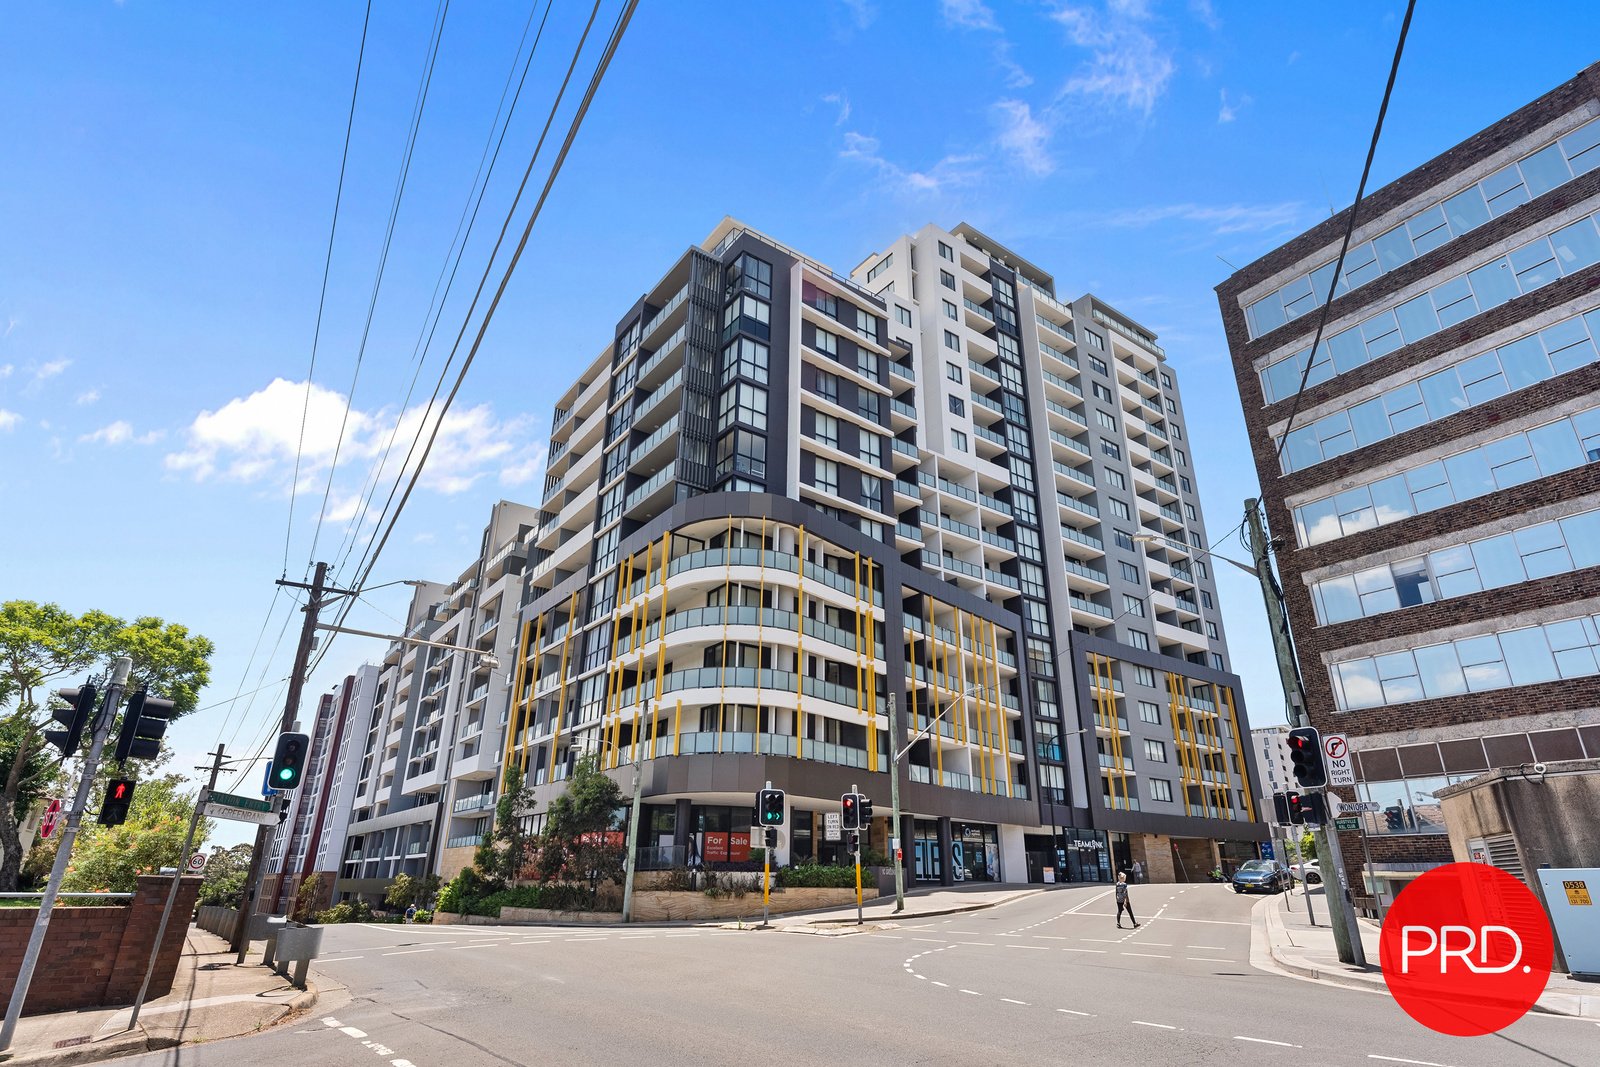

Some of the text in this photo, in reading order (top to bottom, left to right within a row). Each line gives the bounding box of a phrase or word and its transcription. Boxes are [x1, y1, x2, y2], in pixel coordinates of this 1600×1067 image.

[1332, 760, 1345, 768] NO
[1340, 802, 1368, 811] WONIORA
[221, 808, 267, 823] GREENBANK
[707, 836, 748, 846] For Sale
